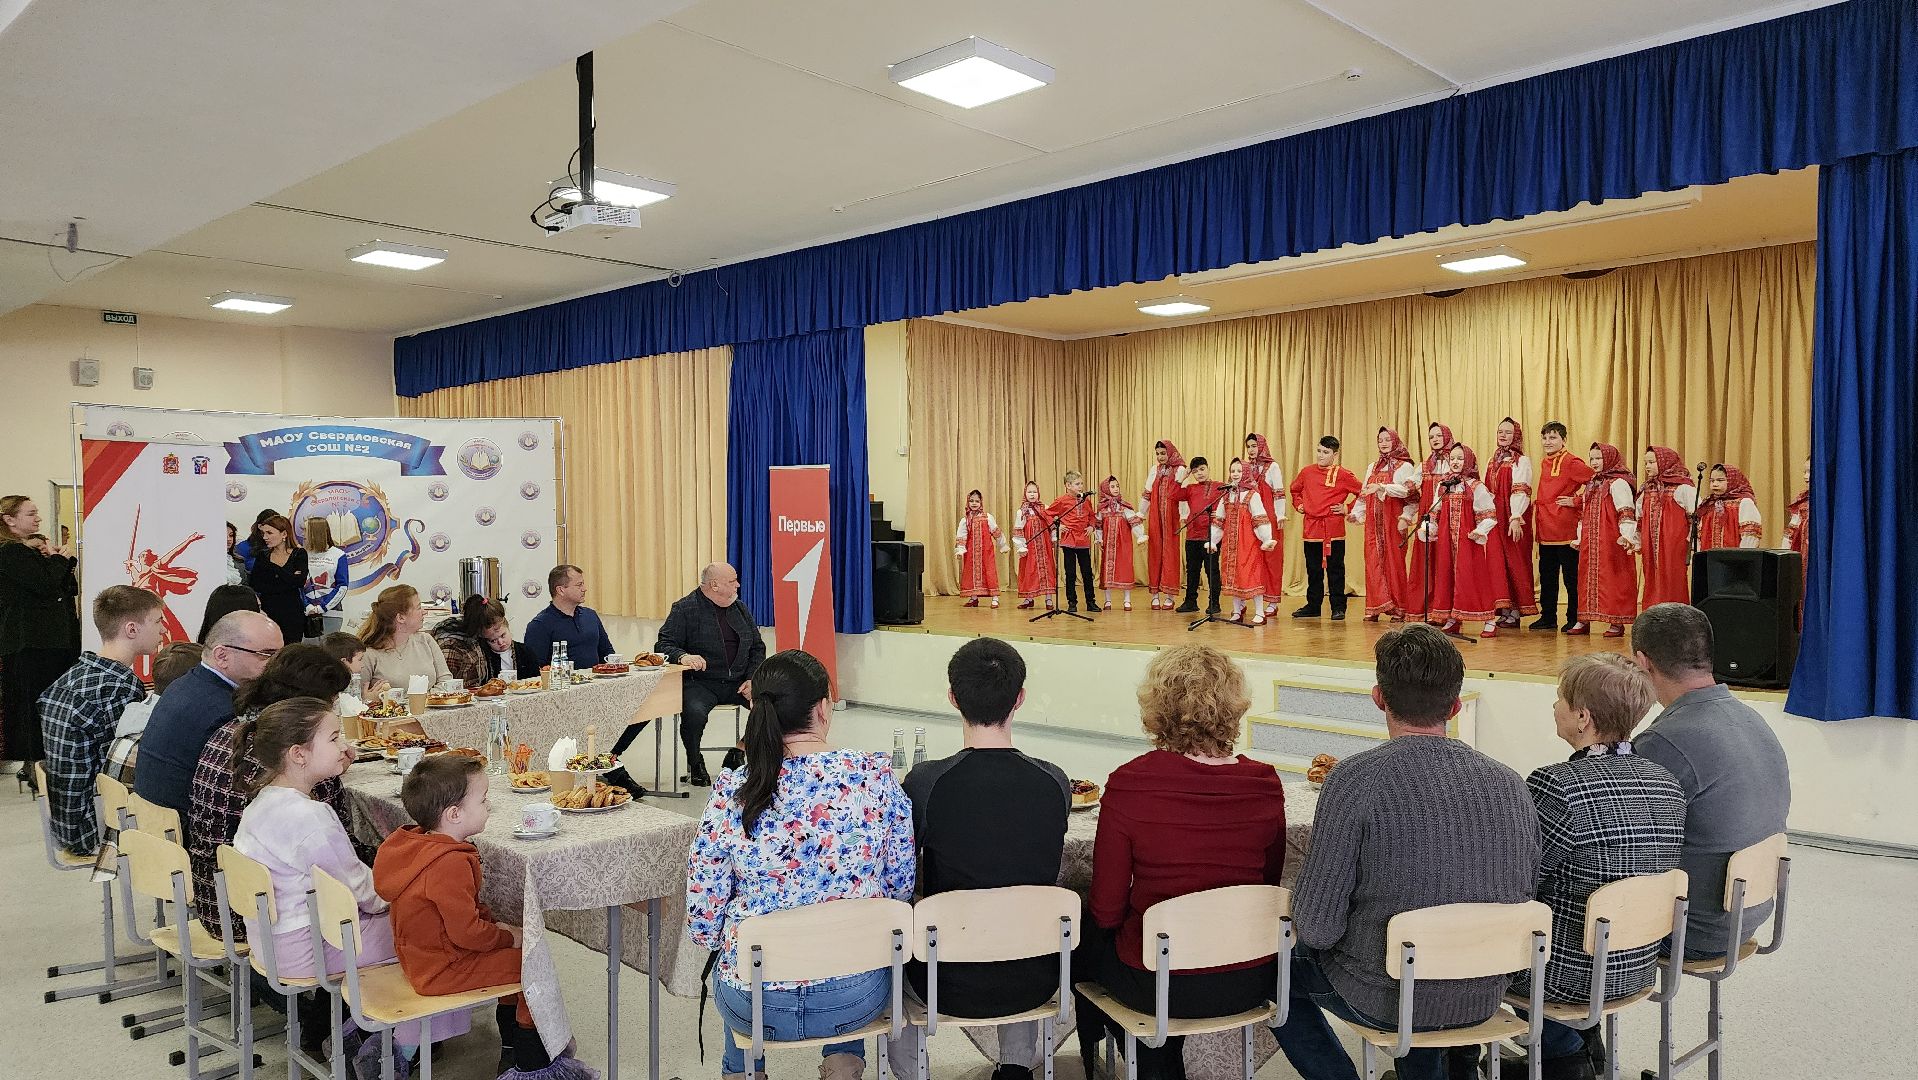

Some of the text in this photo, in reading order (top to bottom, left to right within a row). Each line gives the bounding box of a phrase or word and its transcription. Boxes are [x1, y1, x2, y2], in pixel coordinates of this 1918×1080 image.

[105, 314, 134, 323] ВЫХОД
[259, 431, 412, 450] МАОУ Свердловская
[306, 443, 370, 454] СОШ №2
